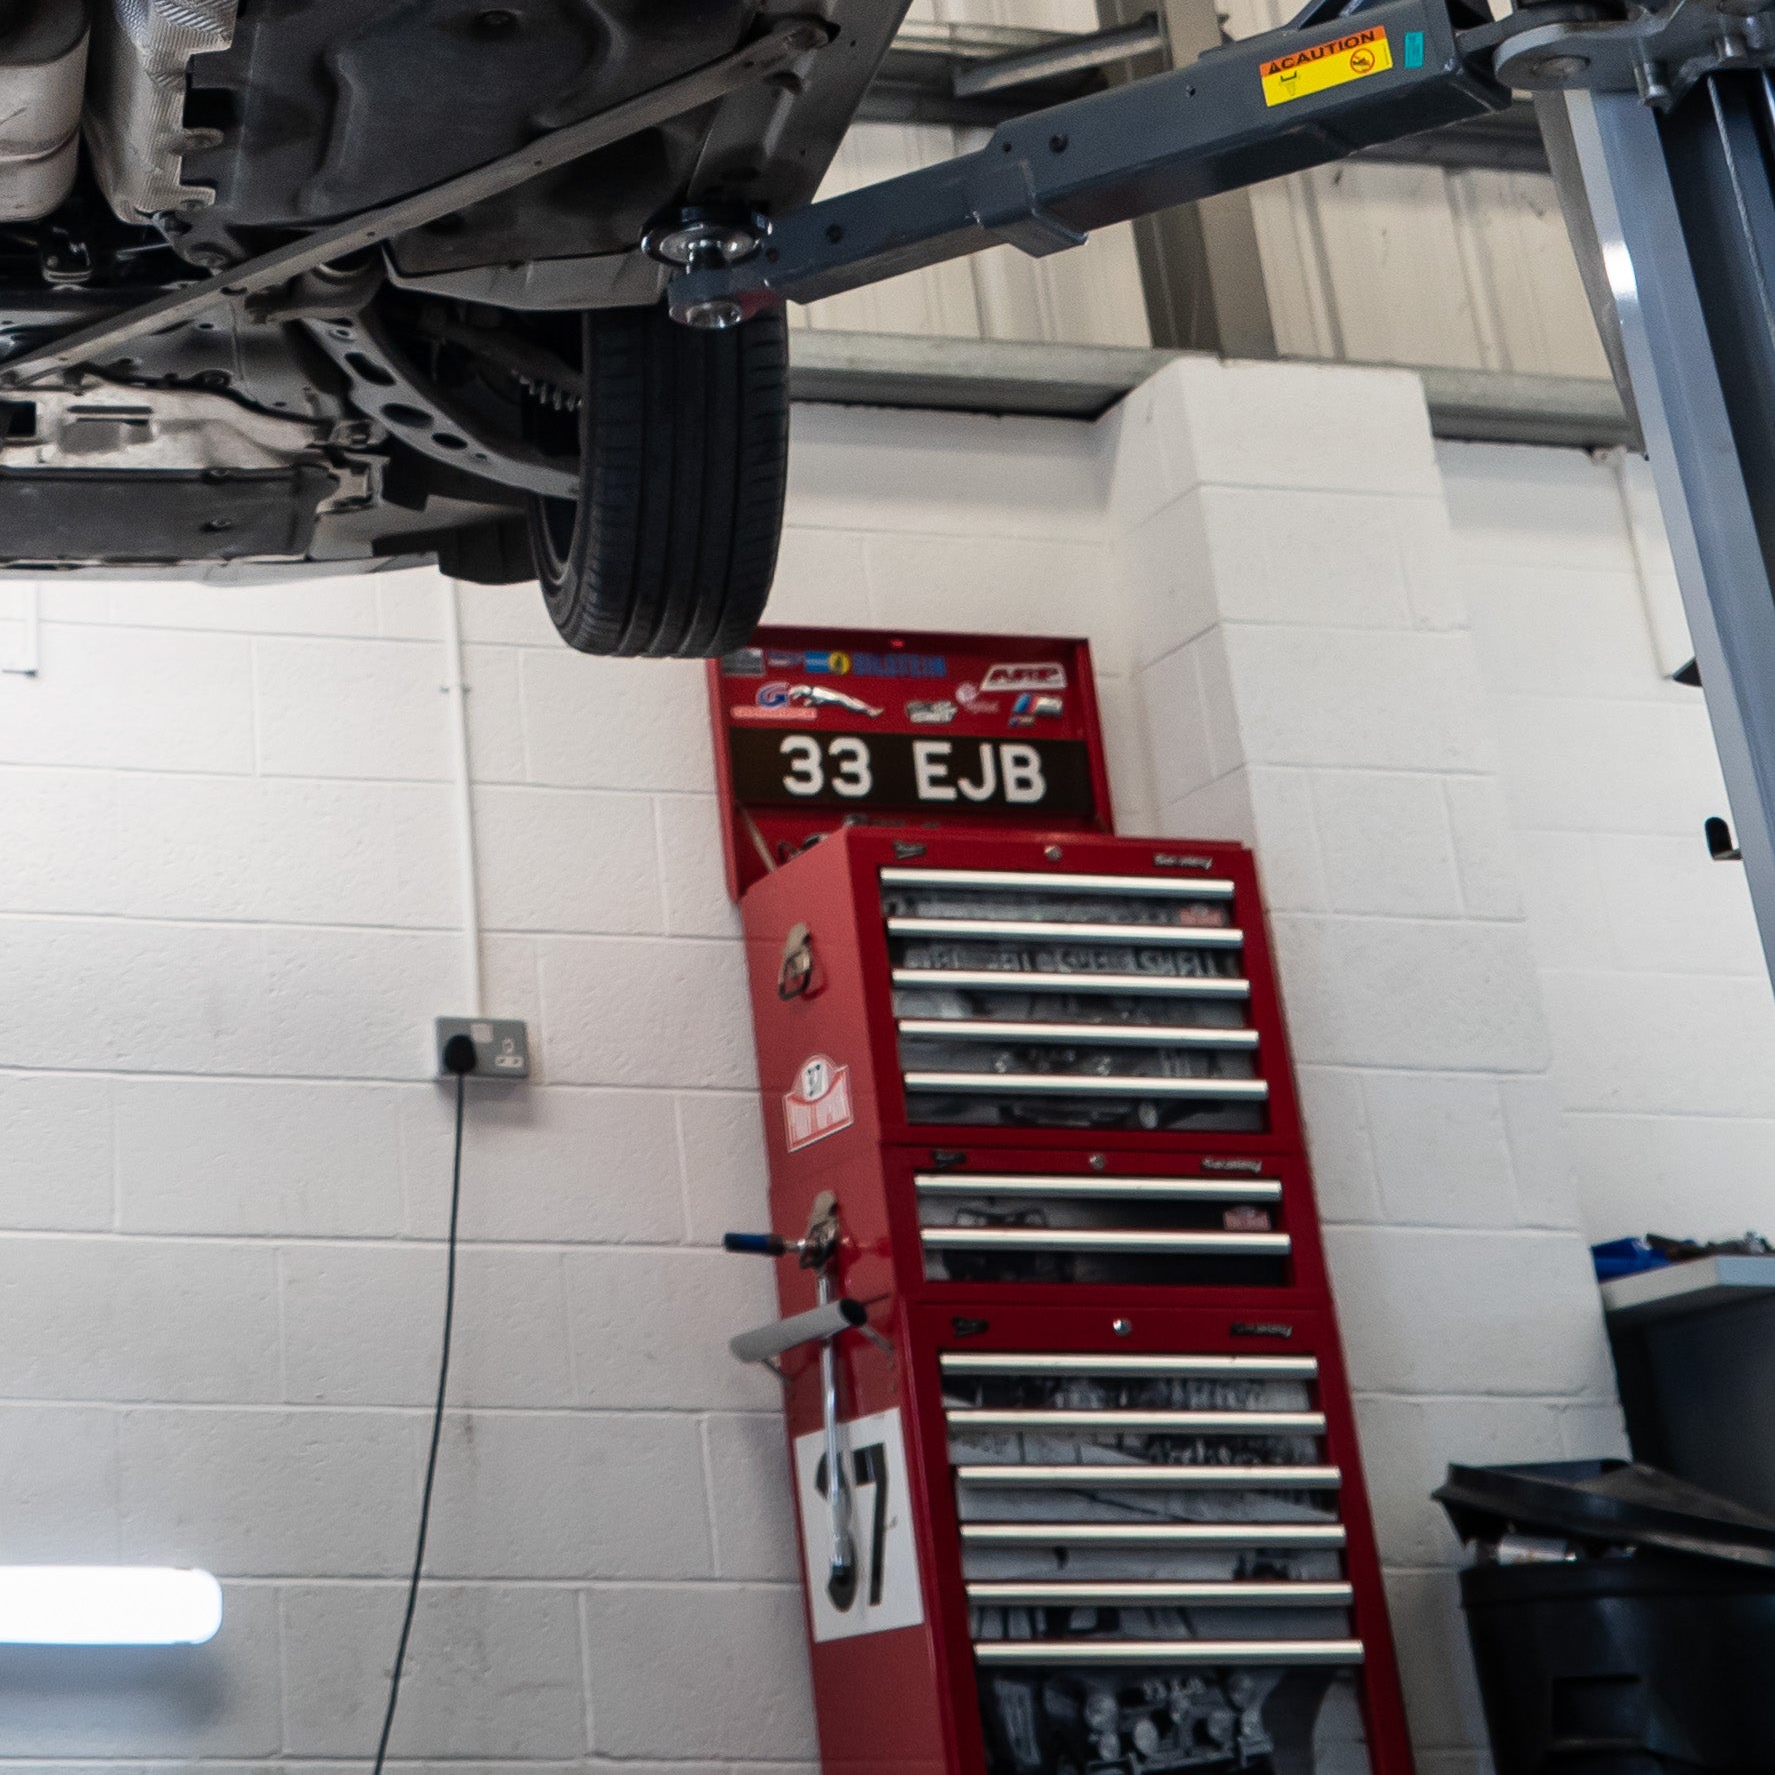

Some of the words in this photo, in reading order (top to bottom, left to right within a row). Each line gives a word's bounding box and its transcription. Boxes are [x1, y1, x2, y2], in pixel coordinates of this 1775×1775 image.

[1281, 30, 1375, 70] CAUTION
[779, 734, 873, 797] 33
[912, 740, 1048, 804] EJB
